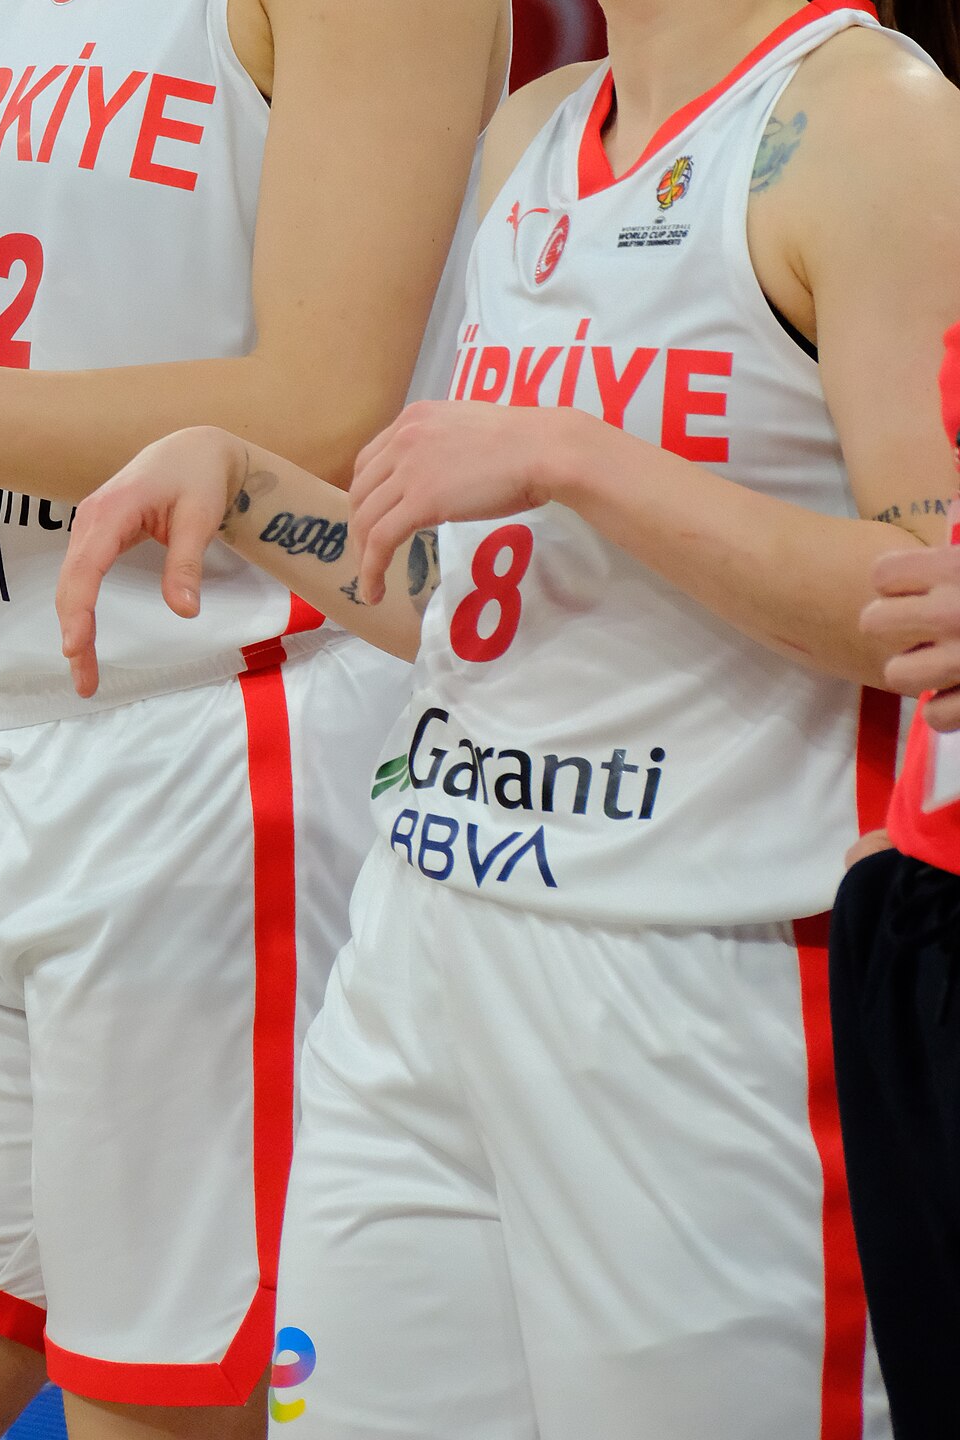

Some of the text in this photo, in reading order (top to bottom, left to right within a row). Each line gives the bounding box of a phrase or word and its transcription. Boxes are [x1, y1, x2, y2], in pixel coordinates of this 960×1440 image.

[618, 229, 689, 240] WORLD CUP 2026
[449, 523, 535, 663] 8
[408, 707, 666, 820] Garanti
